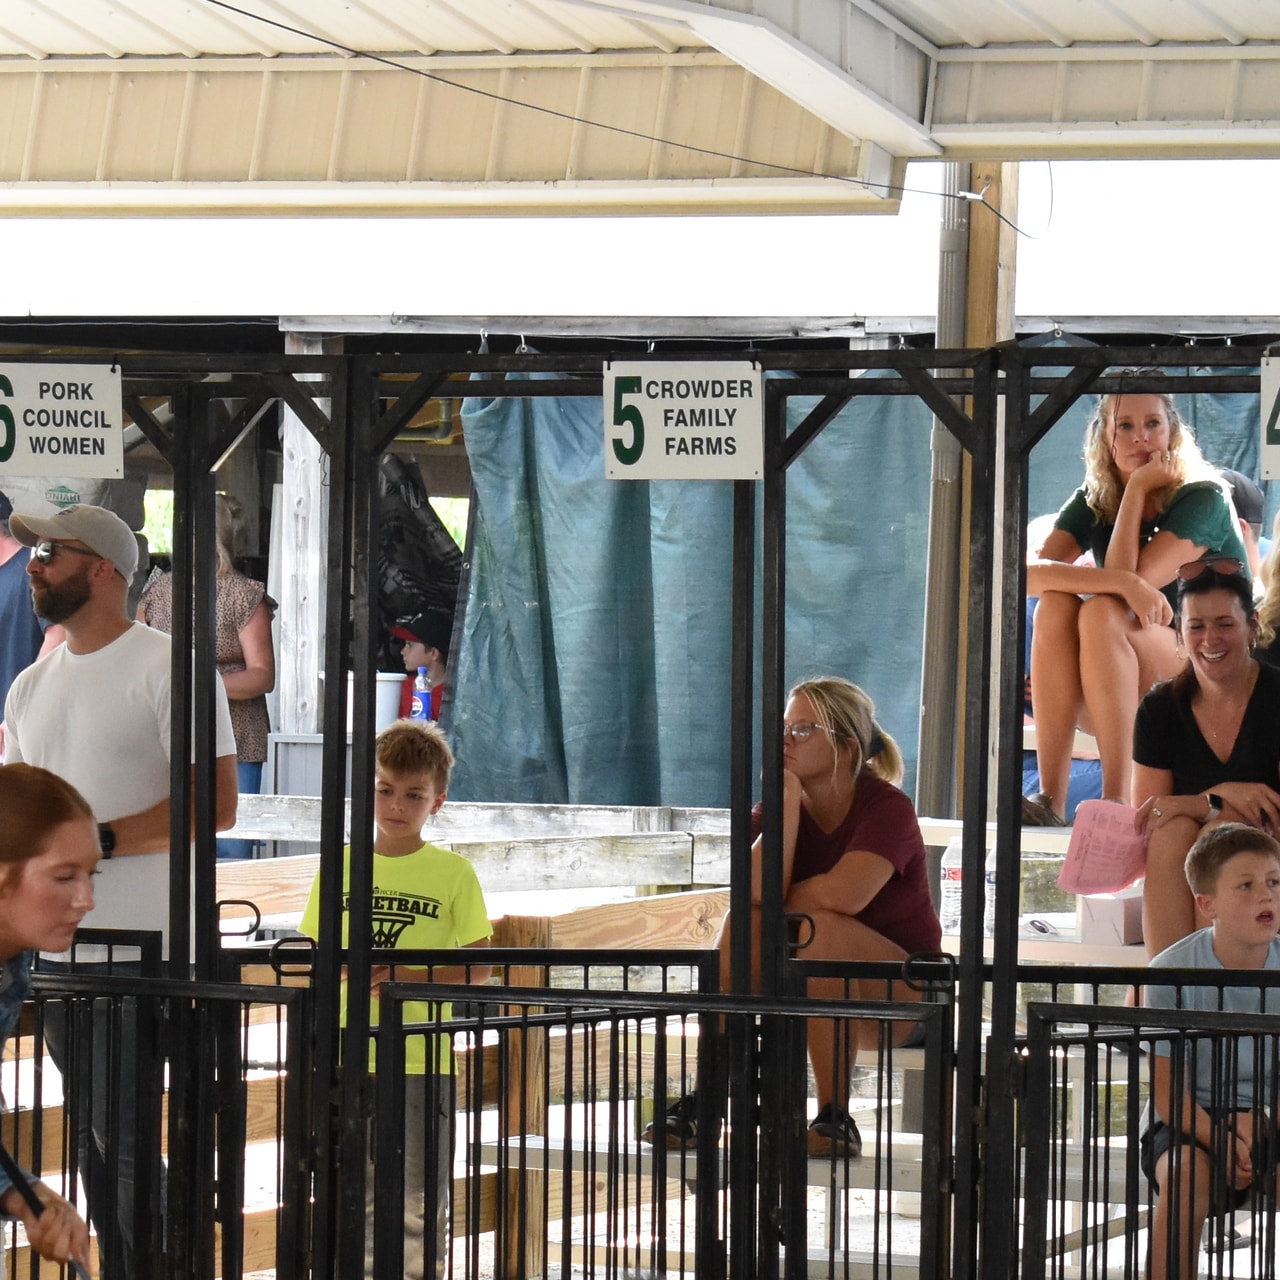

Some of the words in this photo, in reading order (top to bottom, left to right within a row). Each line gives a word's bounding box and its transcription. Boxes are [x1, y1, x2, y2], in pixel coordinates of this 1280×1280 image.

[39, 381, 94, 401] PORK
[645, 379, 753, 399] CROWDER
[22, 408, 111, 429] COUNCIL
[612, 376, 645, 465] 5
[663, 408, 737, 427] FAMILY
[29, 436, 105, 456] WOMEN
[665, 436, 737, 456] FARMS
